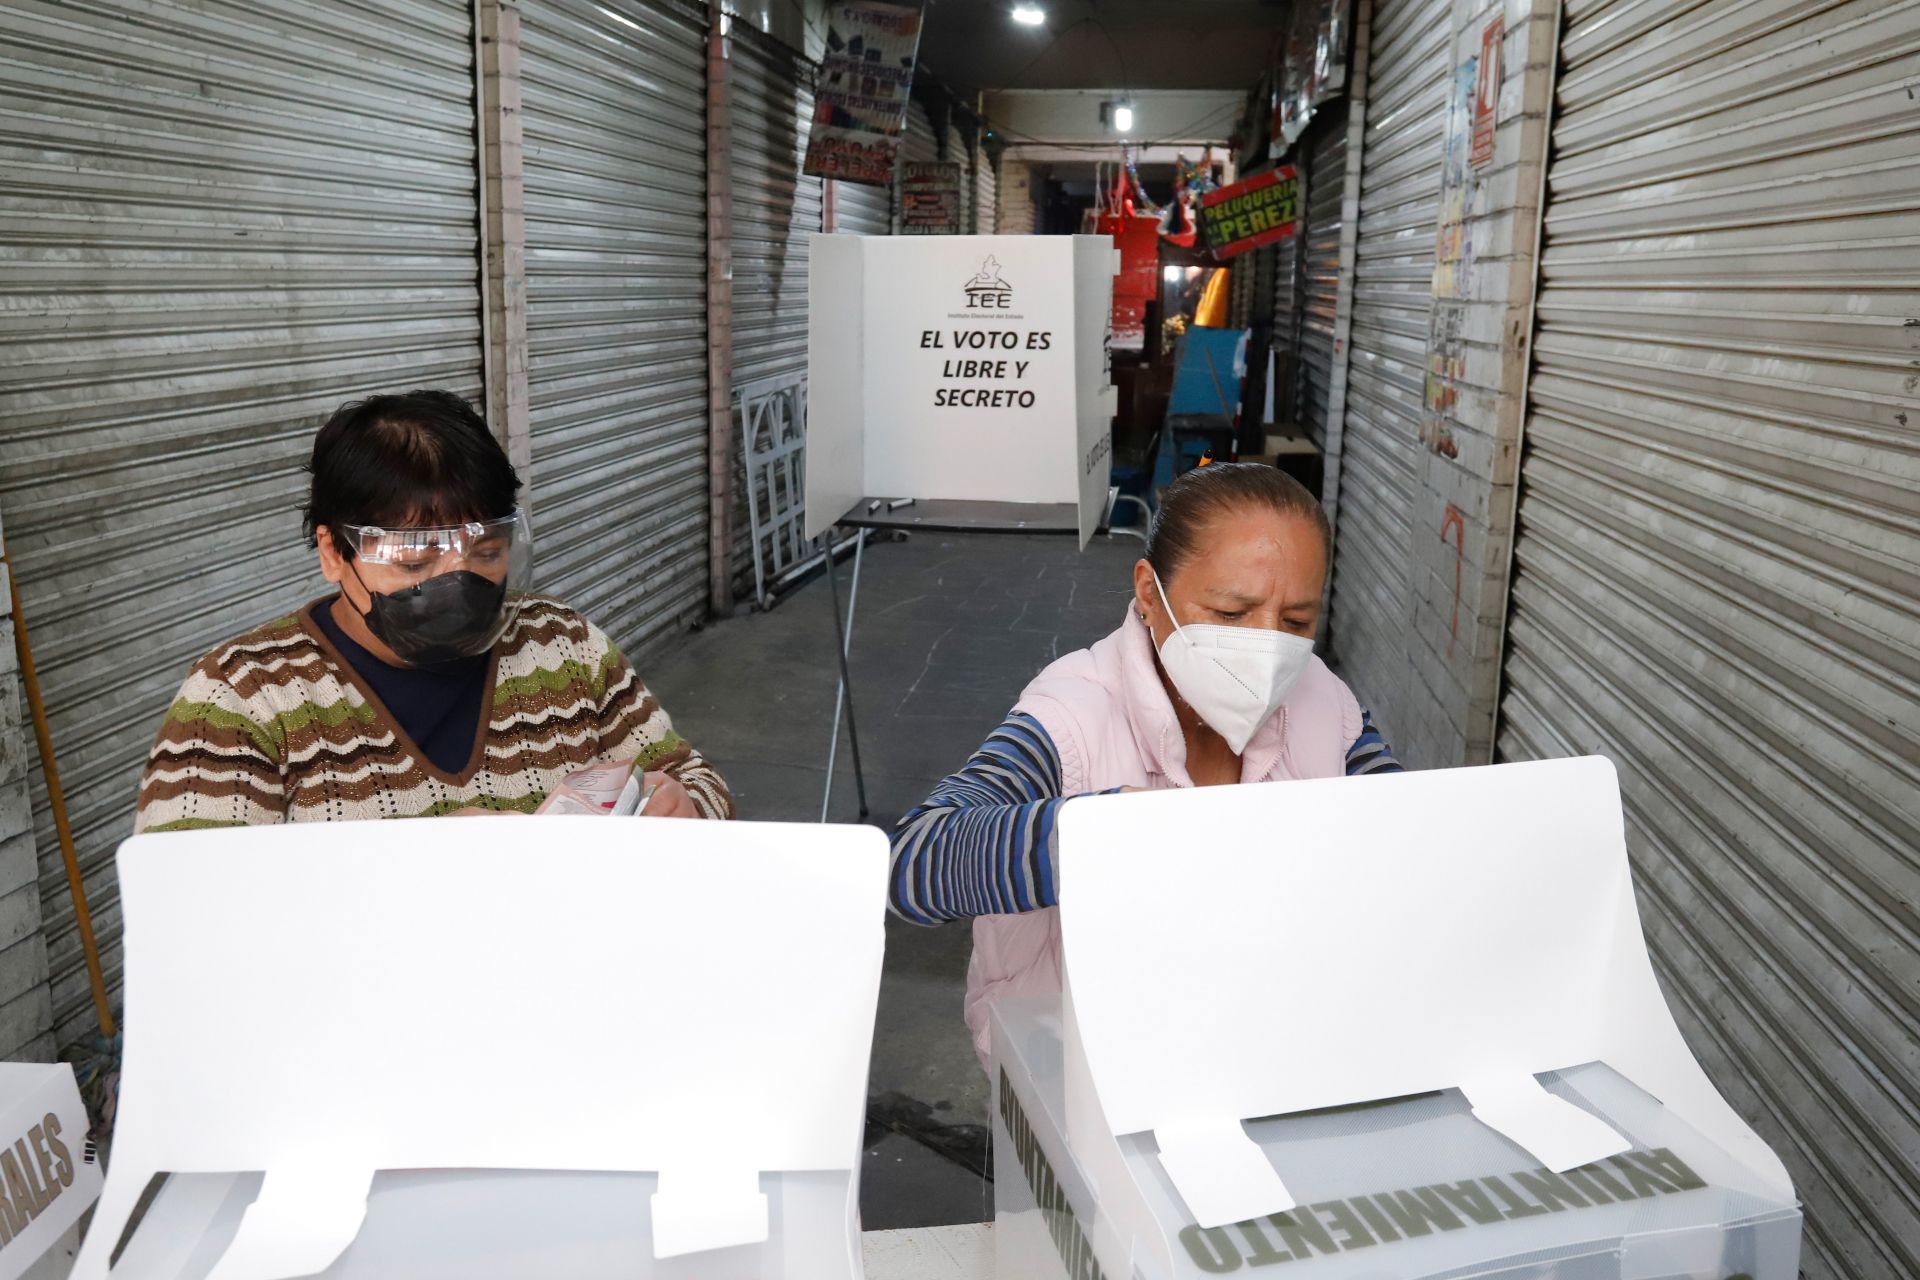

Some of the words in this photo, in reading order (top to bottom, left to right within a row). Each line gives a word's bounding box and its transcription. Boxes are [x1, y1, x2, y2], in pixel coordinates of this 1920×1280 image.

[966, 293, 1012, 308] IEE
[920, 330, 944, 349] EL
[953, 331, 1018, 350] VOTO
[1025, 332, 1052, 350] ES
[943, 360, 1008, 379] LIBRE
[1015, 361, 1029, 379] Y
[934, 389, 1036, 408] SECRETO
[1178, 1147, 1709, 1275] AYUNTAMIENTO
